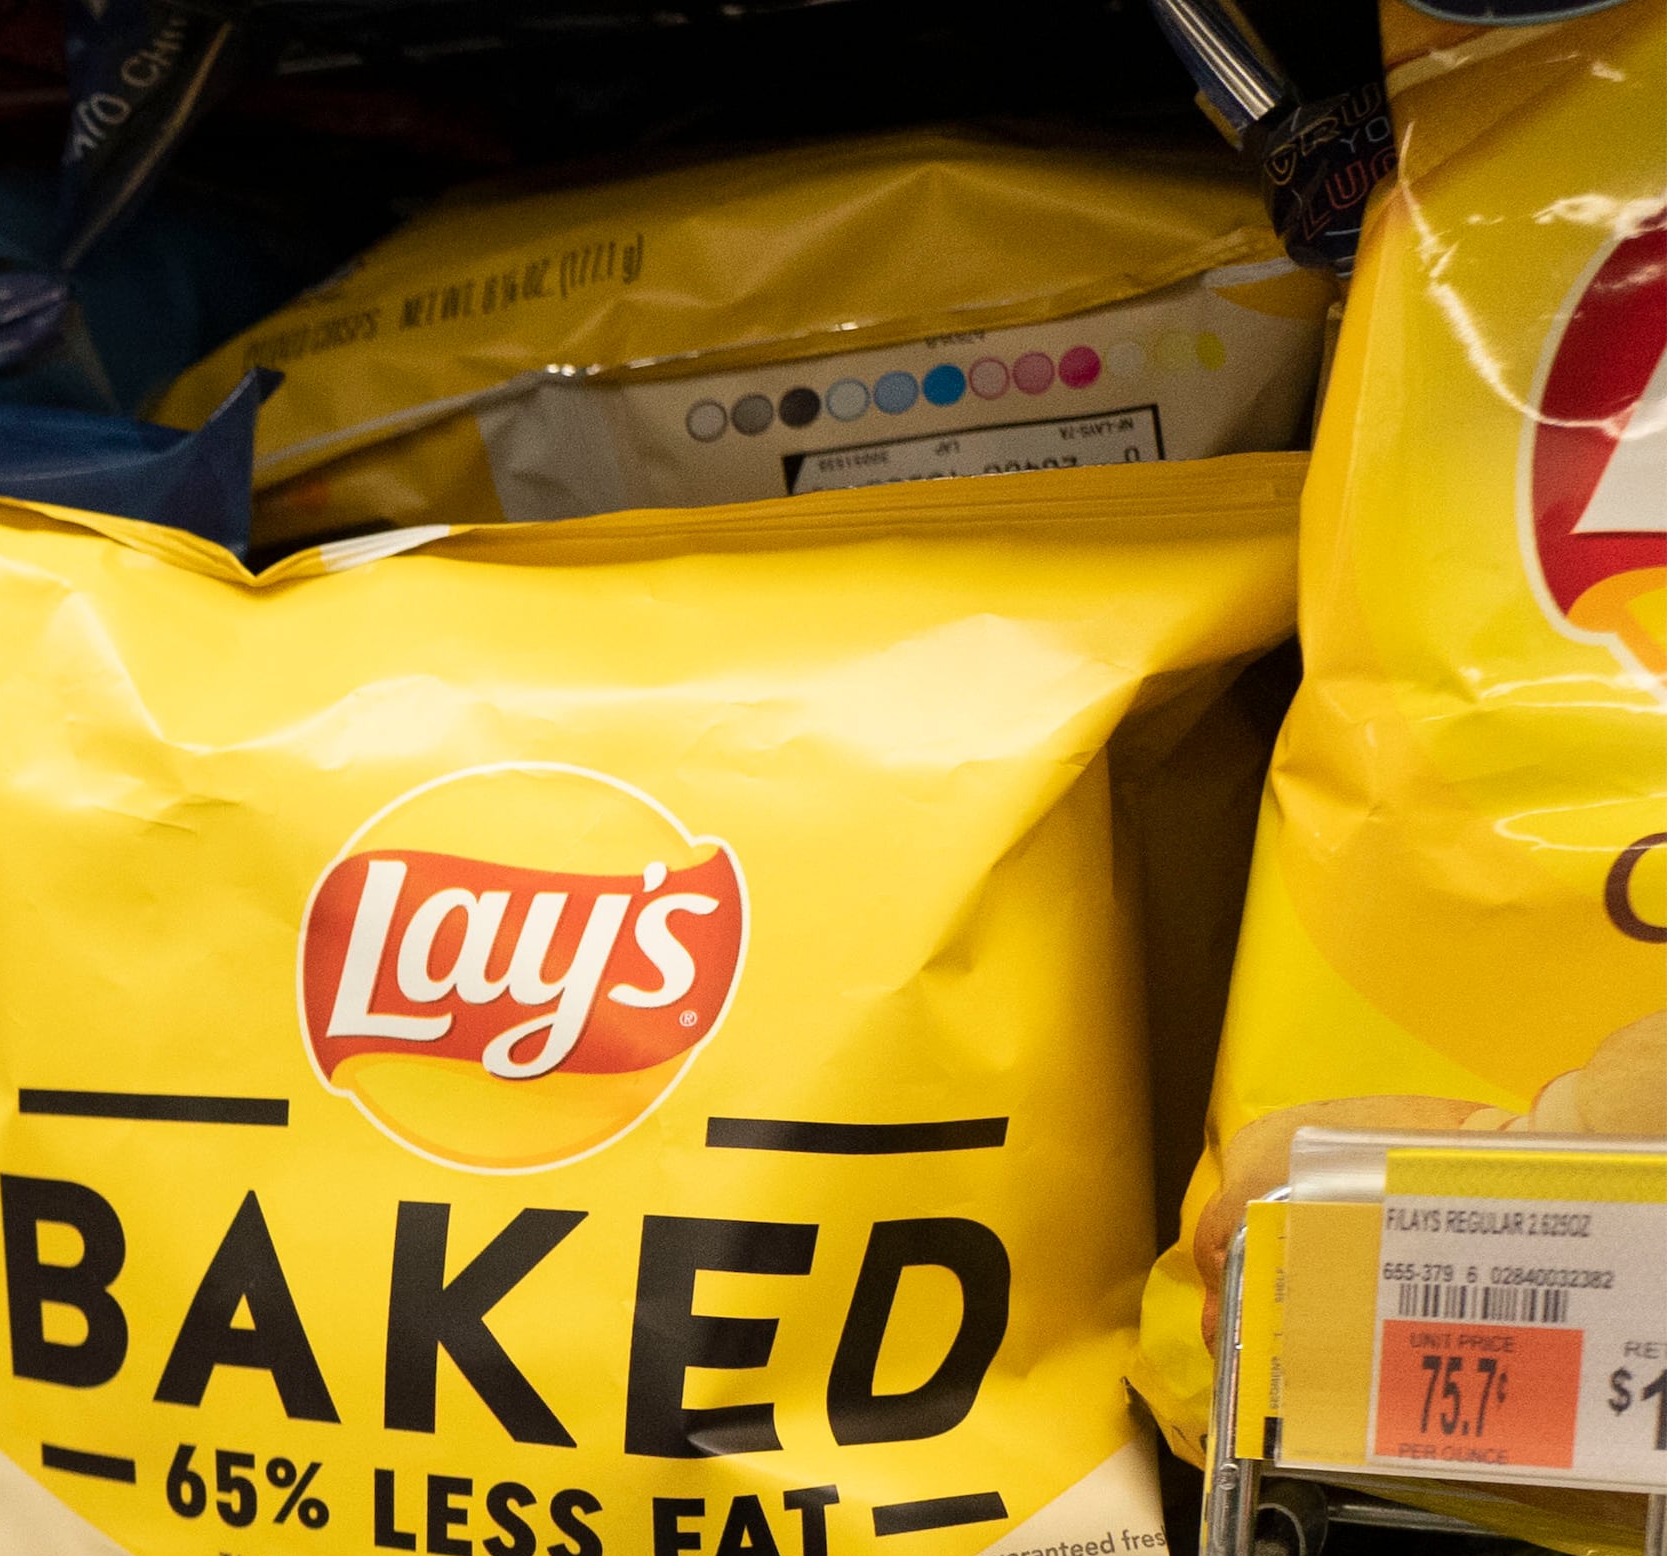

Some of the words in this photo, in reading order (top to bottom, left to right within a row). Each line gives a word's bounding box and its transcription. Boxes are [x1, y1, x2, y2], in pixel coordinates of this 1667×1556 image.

[324, 858, 721, 1080] Lay's
[1446, 1209, 1524, 1236] REGULAR
[1382, 1261, 1455, 1284] 655-379
[0, 1171, 1012, 1460] BAKED
[165, 1443, 331, 1531] 65%
[1121, 1526, 1167, 1552] fres
